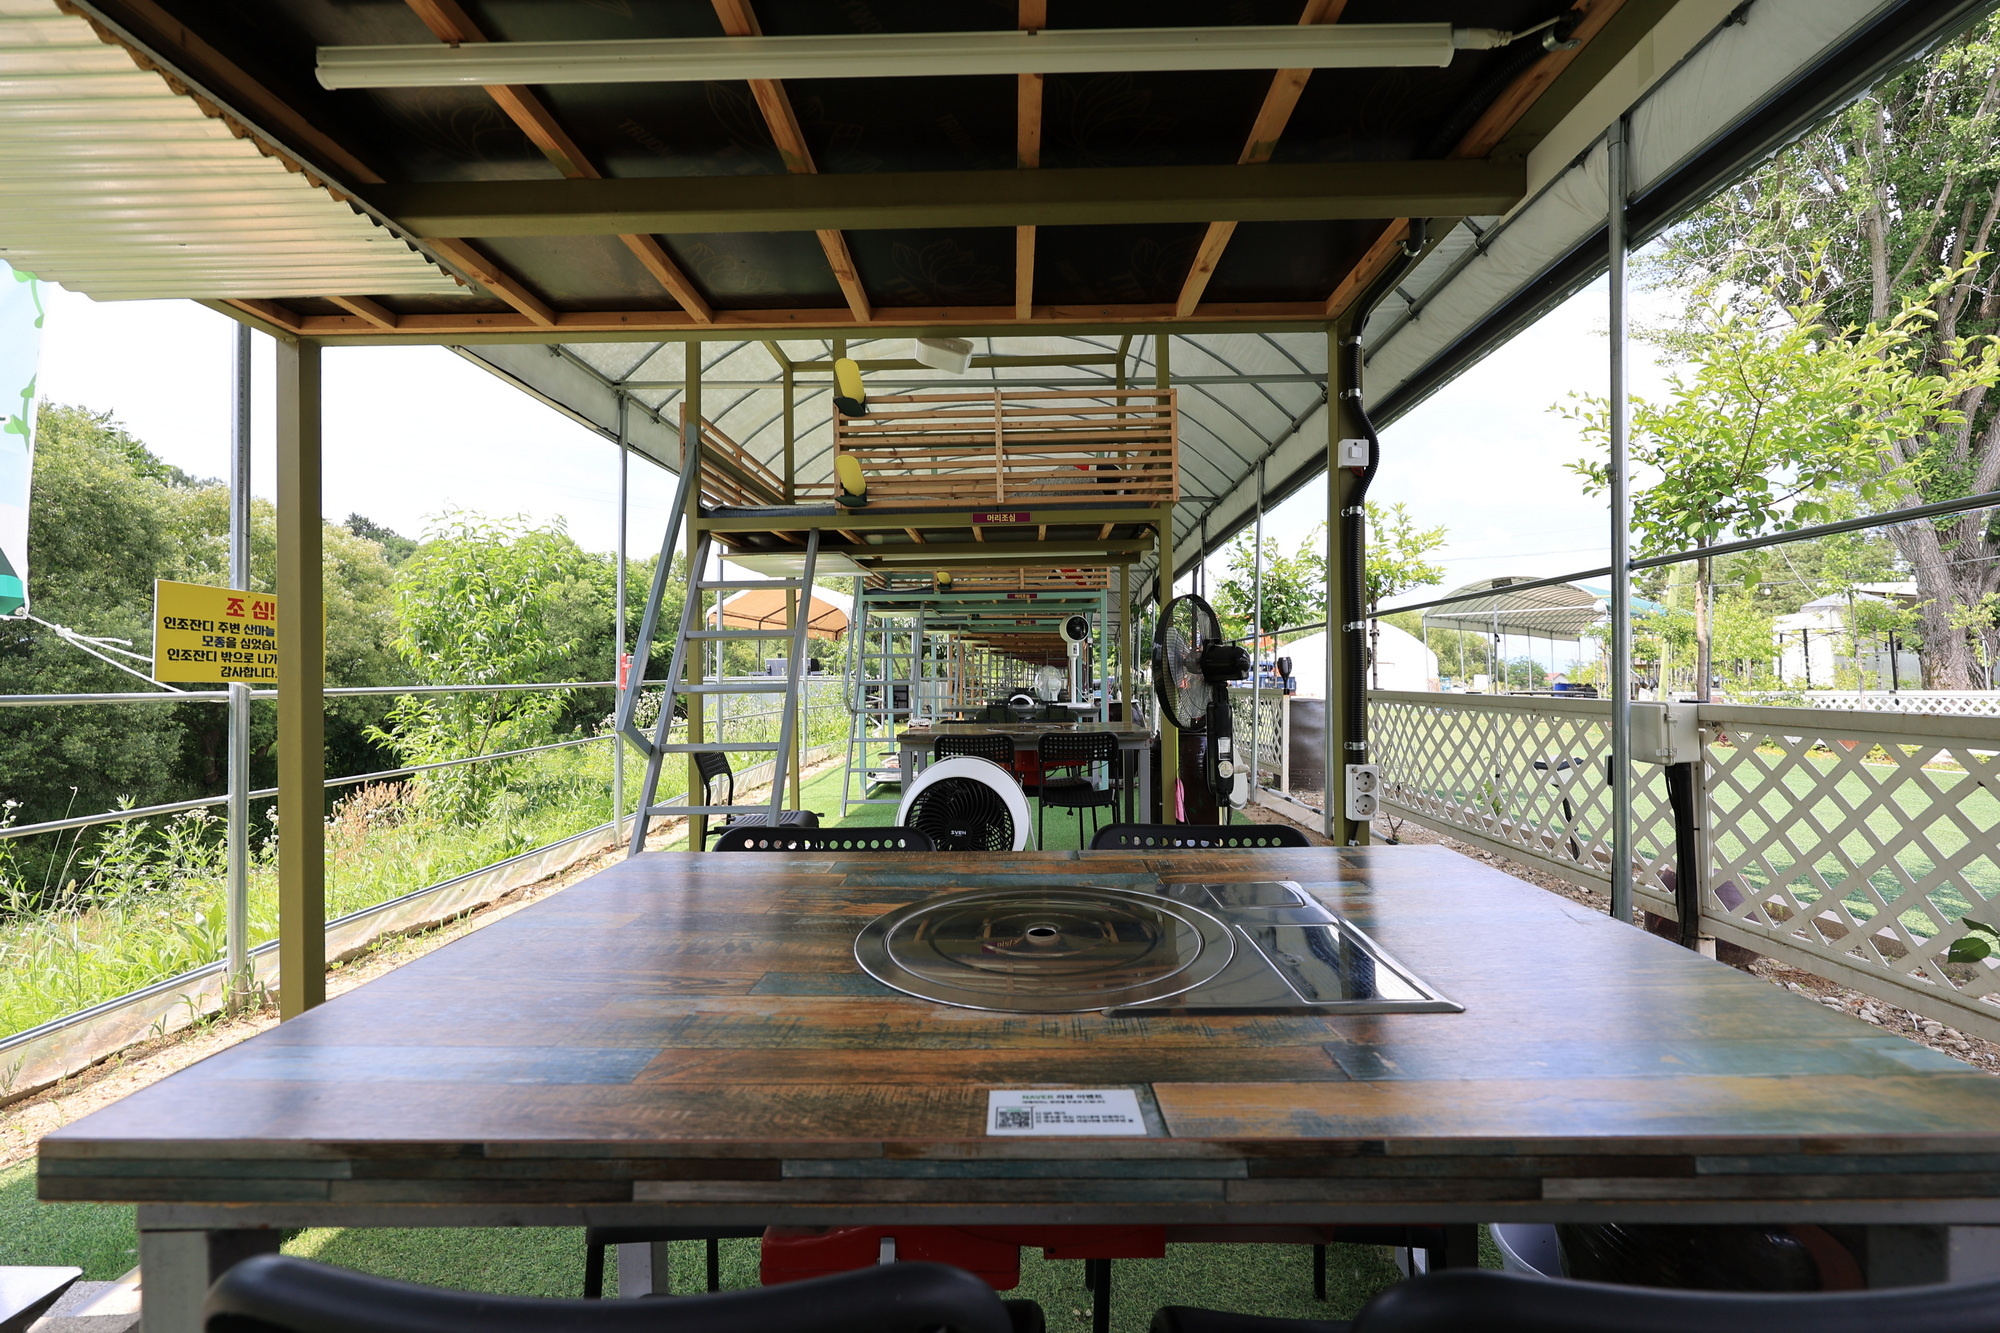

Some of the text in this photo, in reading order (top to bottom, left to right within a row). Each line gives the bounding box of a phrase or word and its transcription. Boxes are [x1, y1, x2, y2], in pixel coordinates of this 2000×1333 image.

[987, 513, 1016, 522] 머리조심
[226, 597, 275, 621] 조 심!
[163, 616, 275, 637] 인조잔디 주변 산마늘
[202, 635, 237, 649] 모종을
[167, 648, 217, 662] 인조잔디
[221, 651, 254, 664] 밖으로
[220, 666, 278, 679] 감사합니다.
